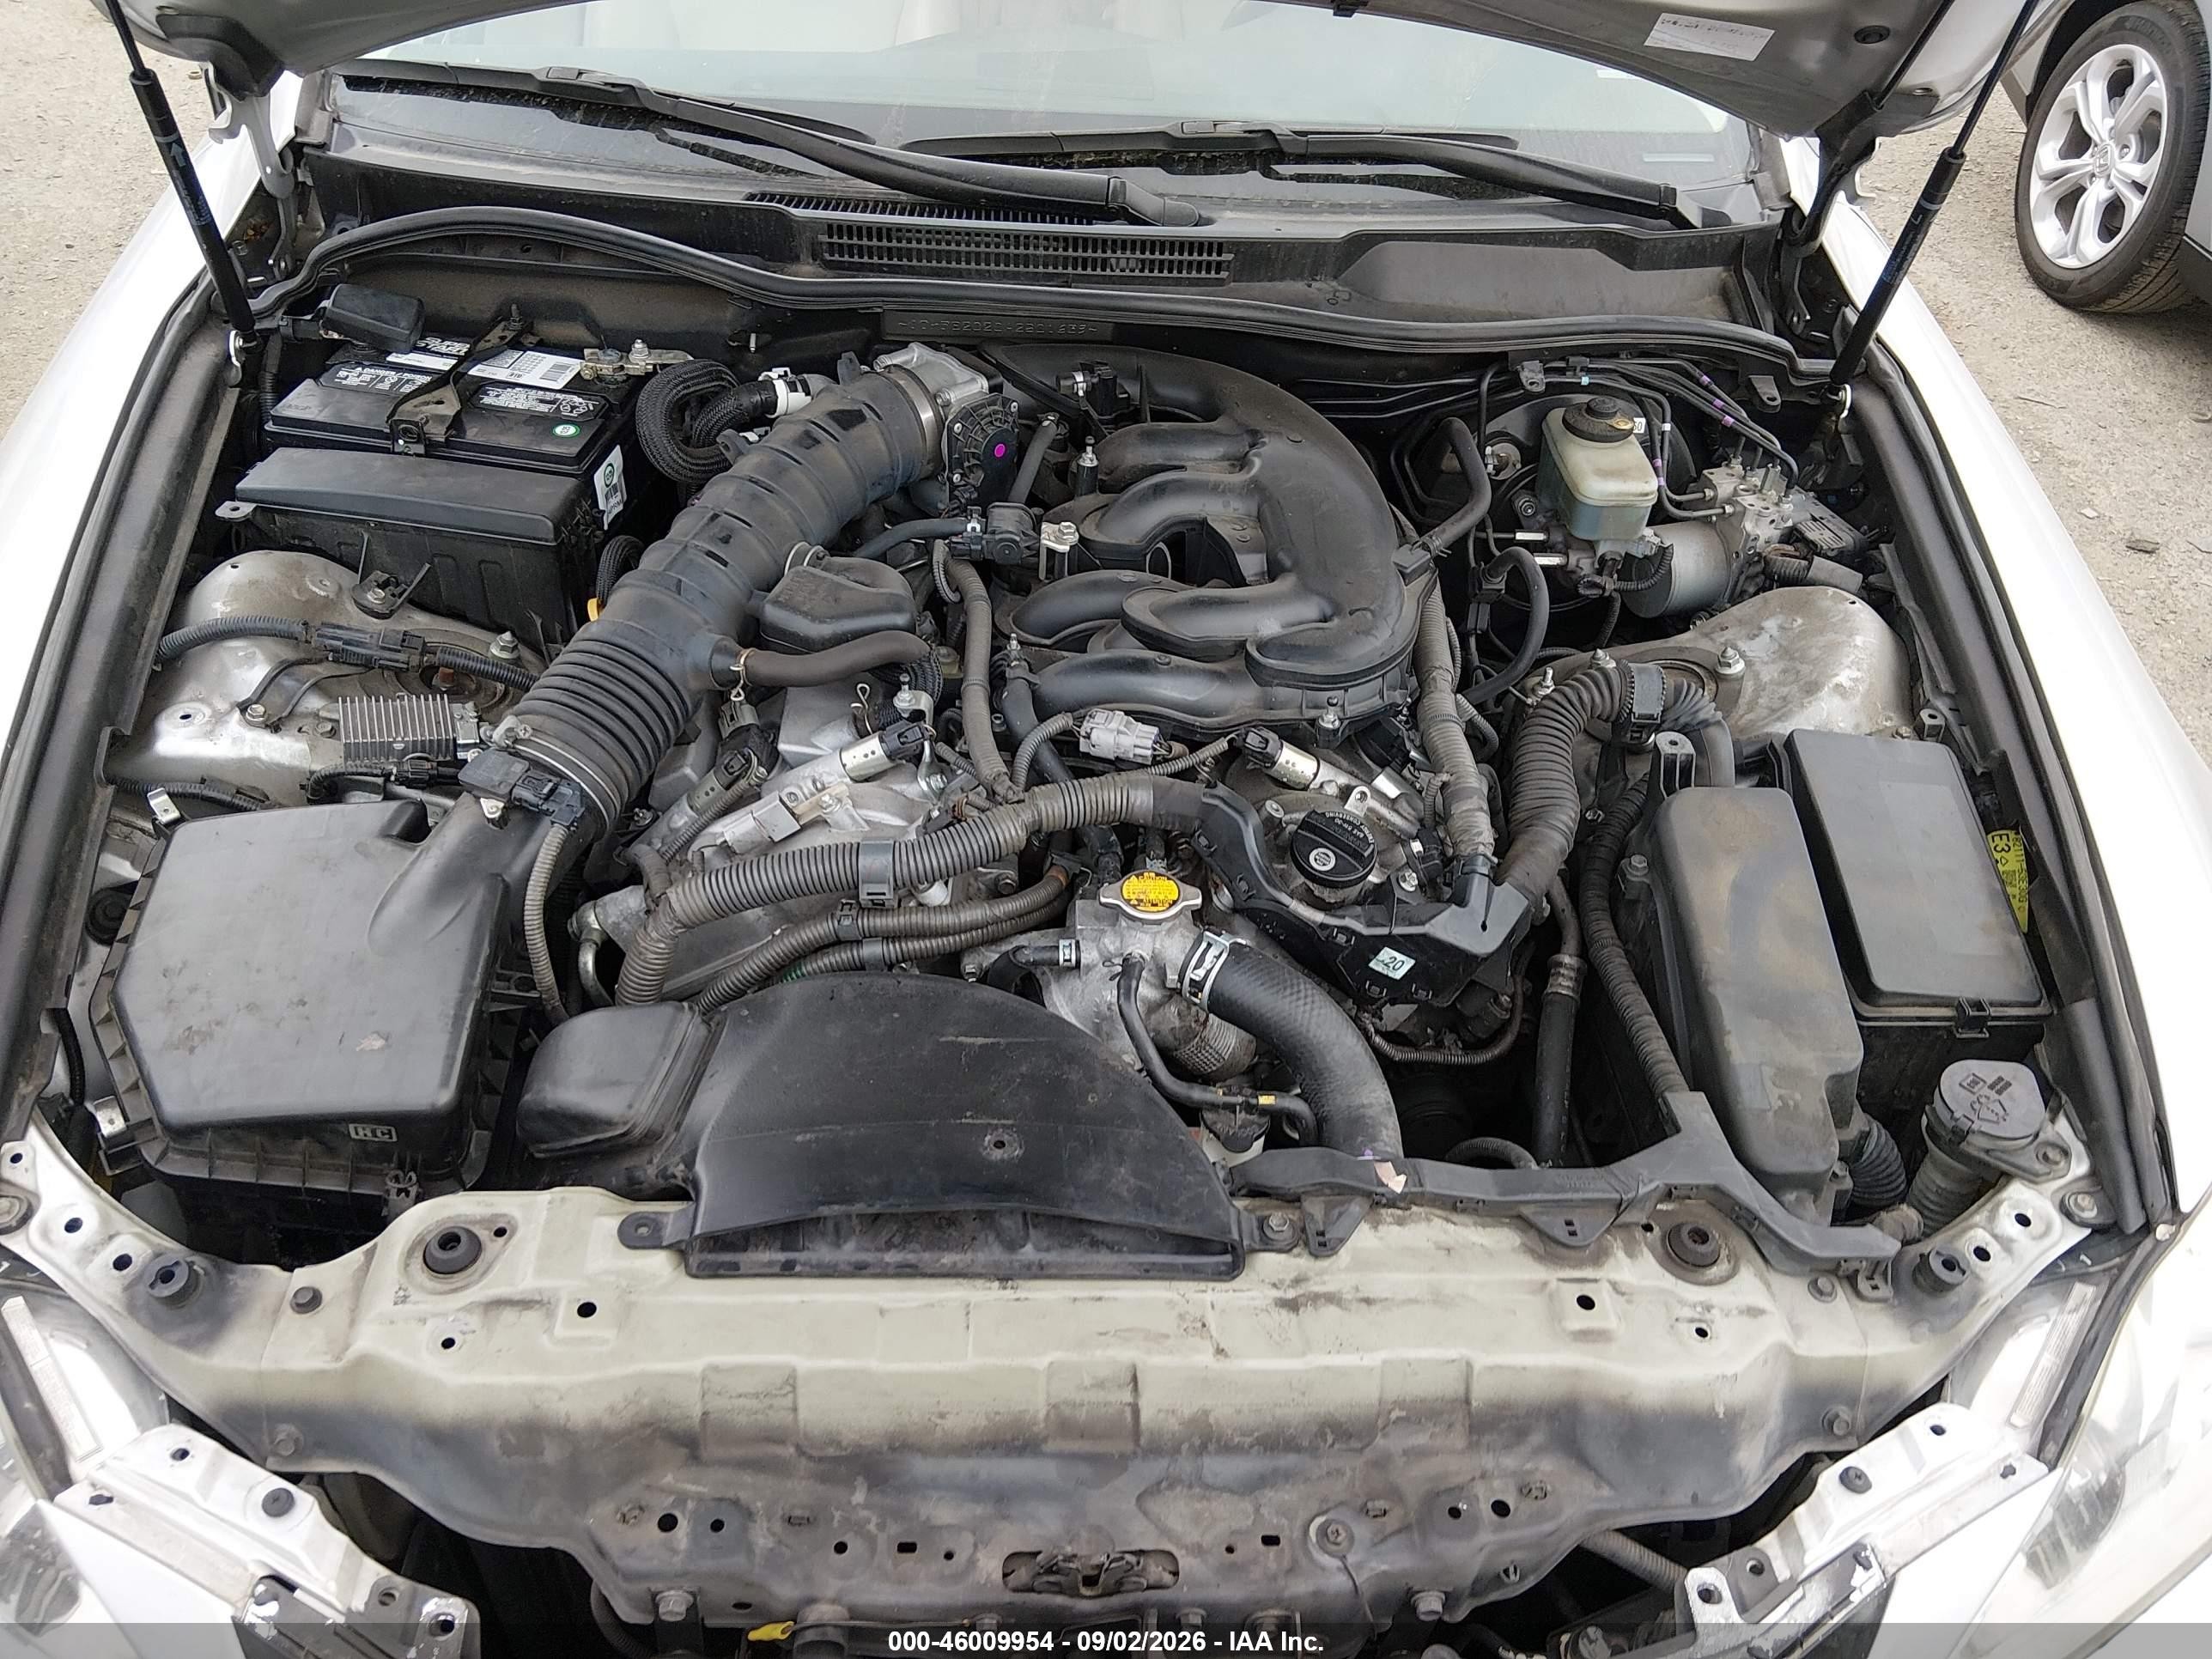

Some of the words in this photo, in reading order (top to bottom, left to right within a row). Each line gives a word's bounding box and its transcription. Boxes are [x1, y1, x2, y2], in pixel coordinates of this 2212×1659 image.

[415, 340, 470, 355] START
[1325, 811, 1361, 825] CONSERVING
[1991, 833, 2011, 854] E3
[1382, 956, 1406, 971] 20
